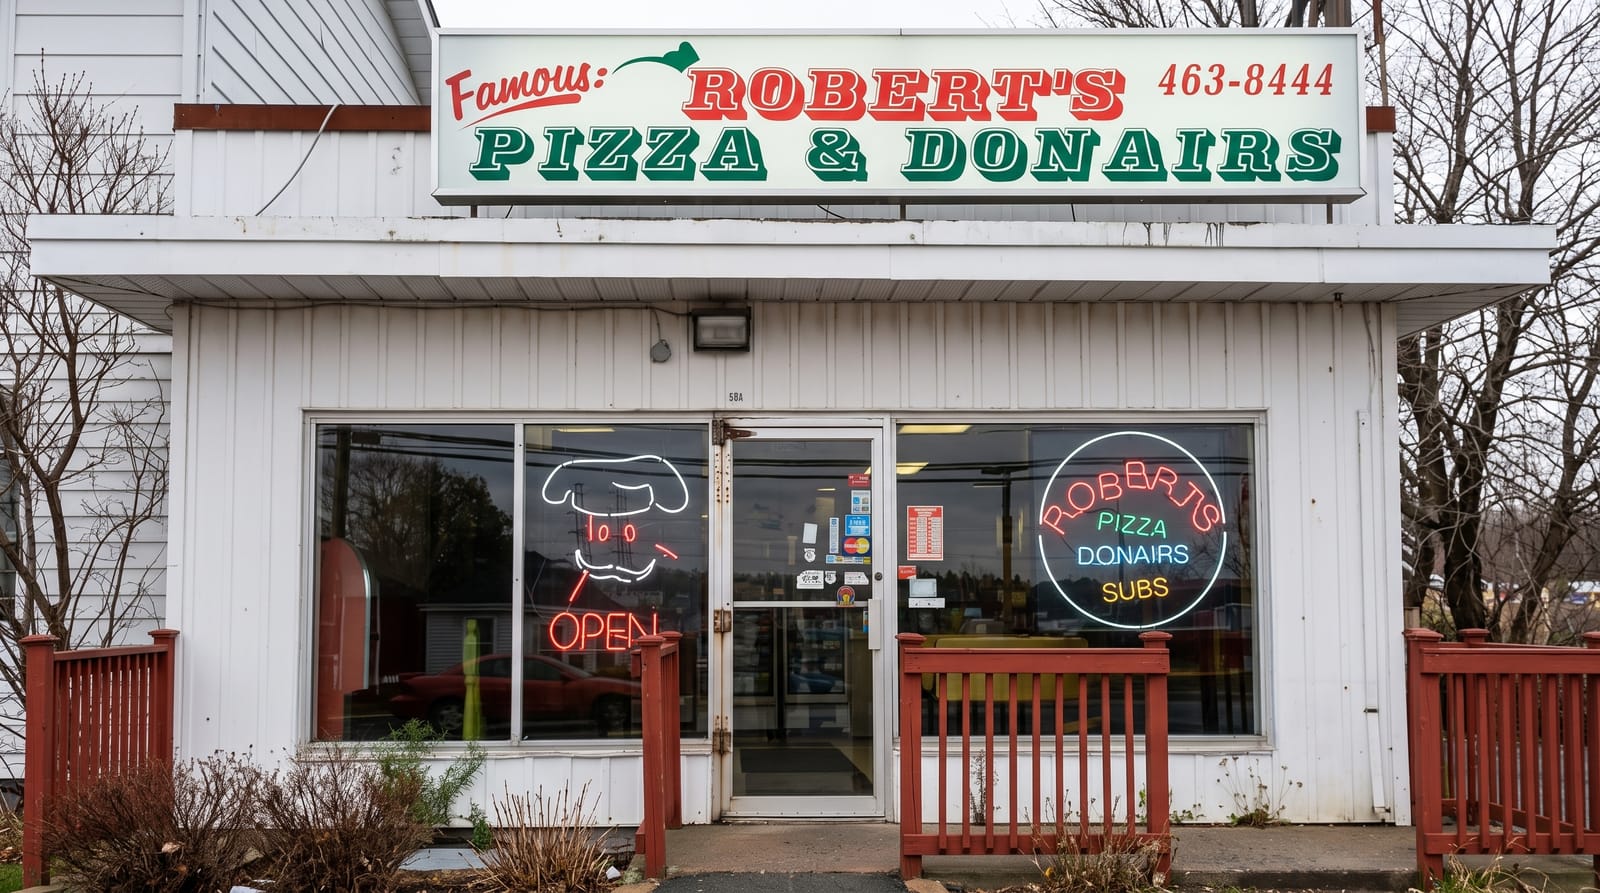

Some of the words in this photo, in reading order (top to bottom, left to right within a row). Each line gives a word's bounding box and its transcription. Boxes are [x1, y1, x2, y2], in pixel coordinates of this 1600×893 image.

[445, 62, 608, 122] Famous:
[681, 67, 1126, 121] ROBERT'S
[1158, 63, 1334, 96] 463-8444
[468, 126, 768, 181] PIZZA
[804, 126, 868, 182] &
[900, 127, 1342, 182] DONAIRS
[728, 392, 744, 402] 58A
[1043, 461, 1220, 536] ROBERTS
[1098, 511, 1166, 539] PIZZA
[1078, 544, 1189, 566] DONAIRS
[1102, 577, 1169, 603] SUBS
[549, 612, 658, 650] OPEN
